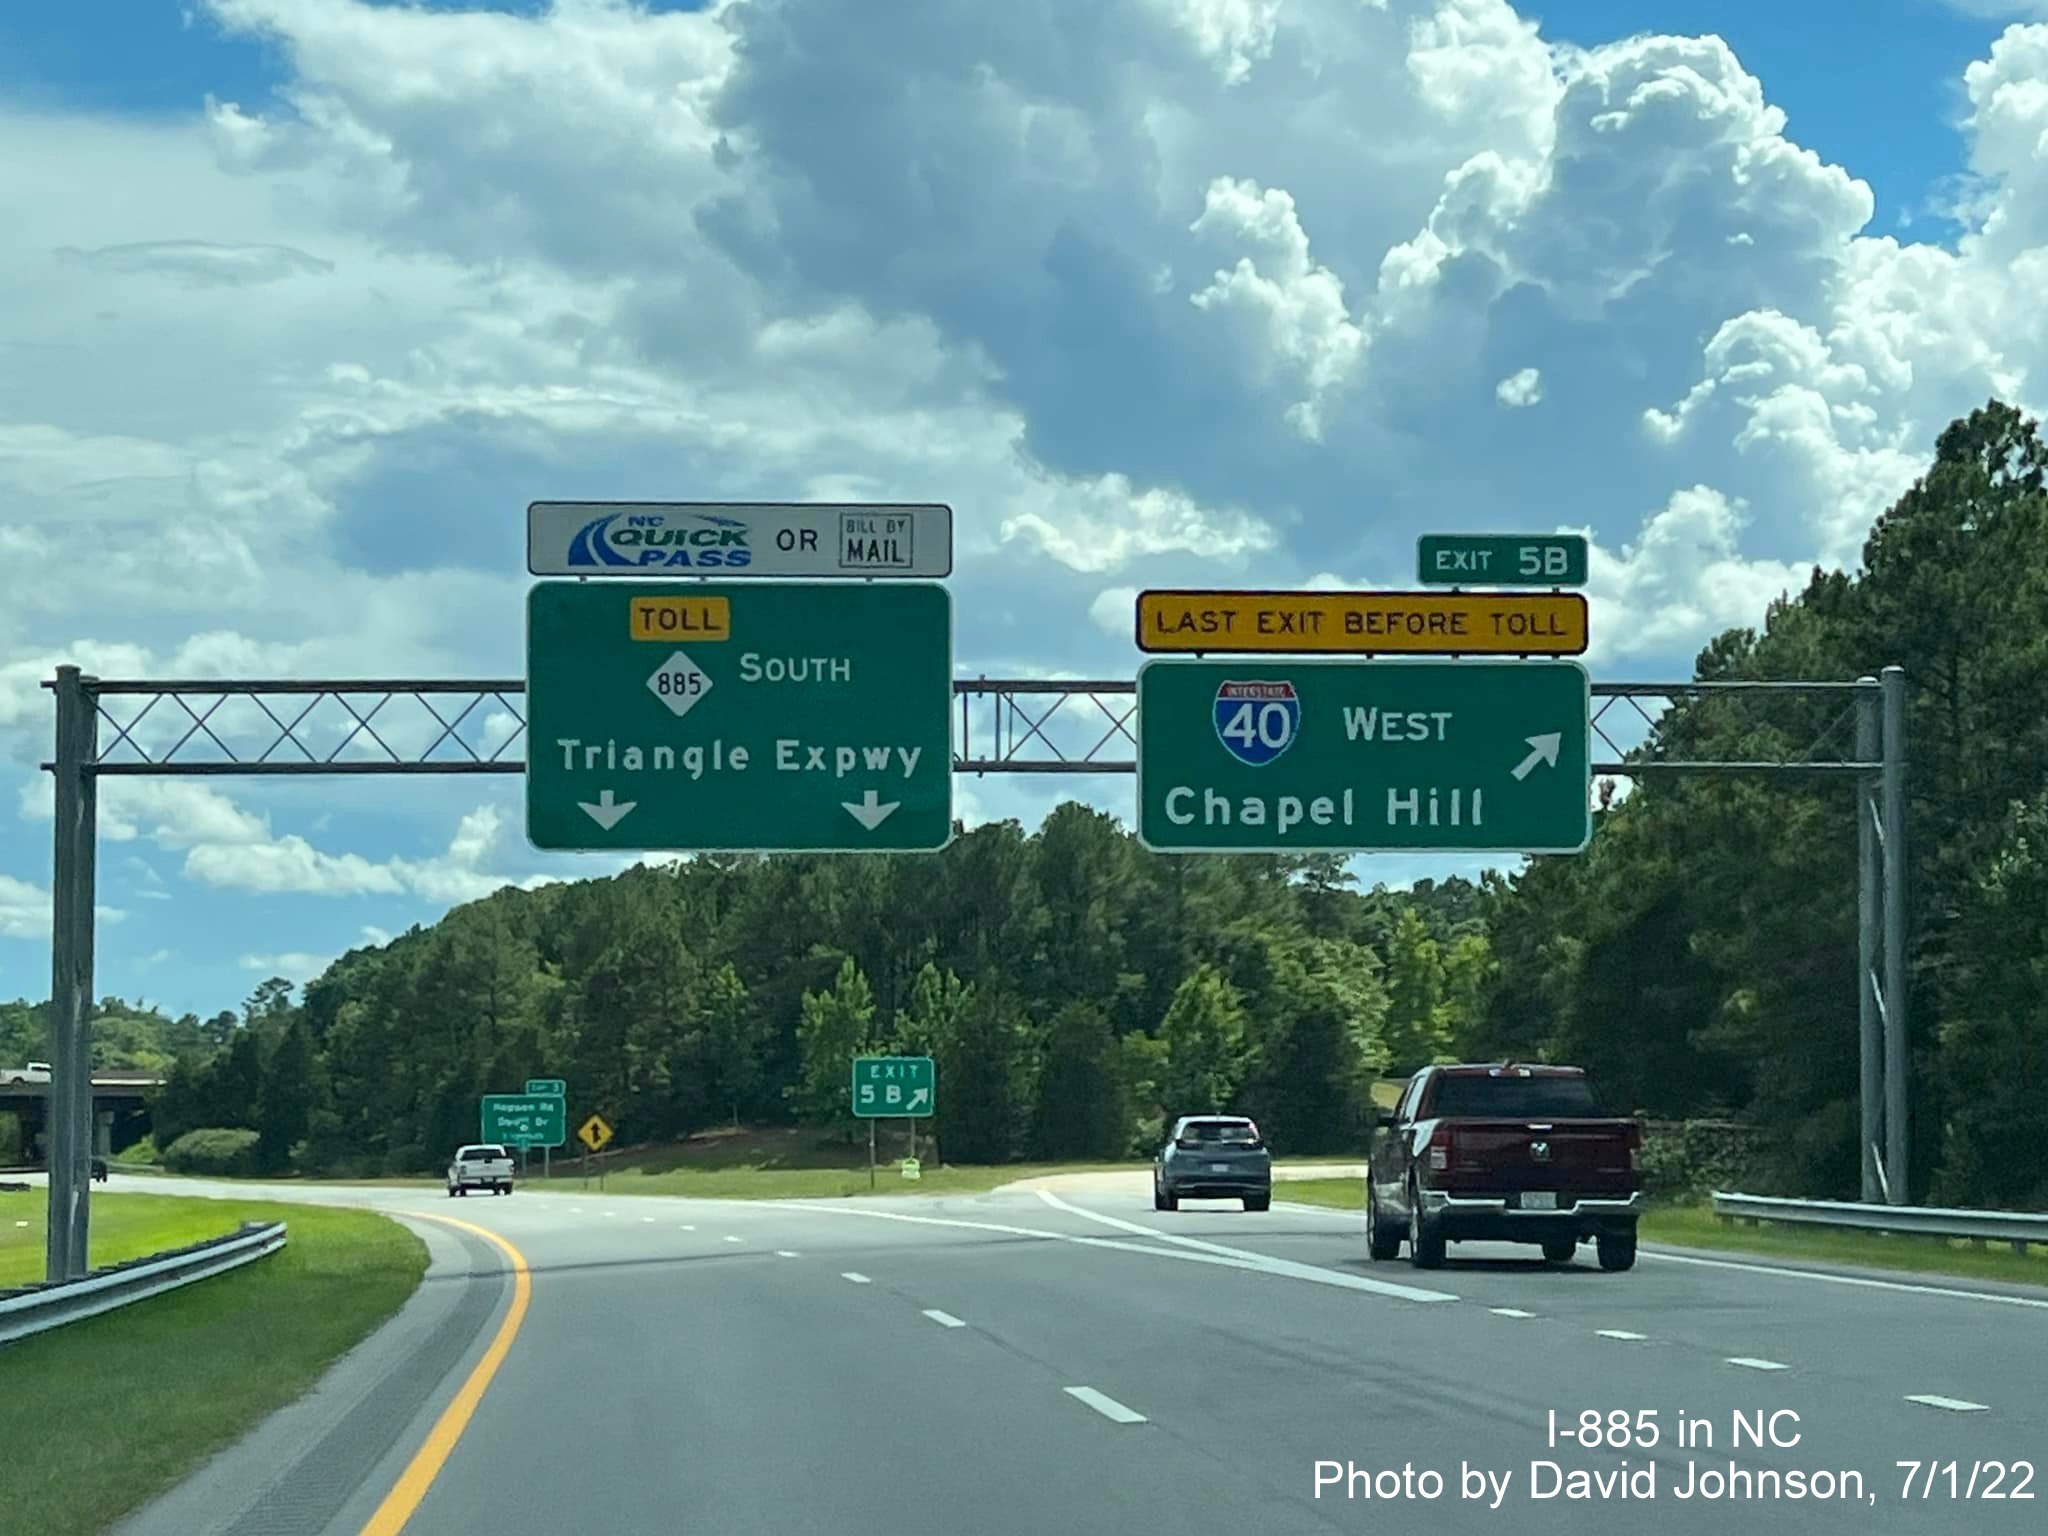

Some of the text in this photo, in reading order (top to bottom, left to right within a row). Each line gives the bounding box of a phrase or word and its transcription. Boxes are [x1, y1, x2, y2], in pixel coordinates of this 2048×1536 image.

[628, 515, 664, 527] NC
[846, 519, 906, 533] BILL BY
[611, 529, 748, 547] QUICK
[776, 529, 818, 551] OR
[638, 550, 751, 567] PASS
[846, 538, 905, 563] MAIL
[1436, 547, 1568, 576] EXIT 5B
[639, 608, 721, 631] TOLL
[1157, 610, 1567, 636] LAST EXIT BEFORE TOLL
[657, 653, 850, 696] 885 SOUTH
[1222, 702, 1452, 749] 40 WEST
[557, 739, 921, 780] Triangle Expwy
[1165, 787, 1482, 834] Chapel Hill
[870, 1065, 918, 1078] EXIT
